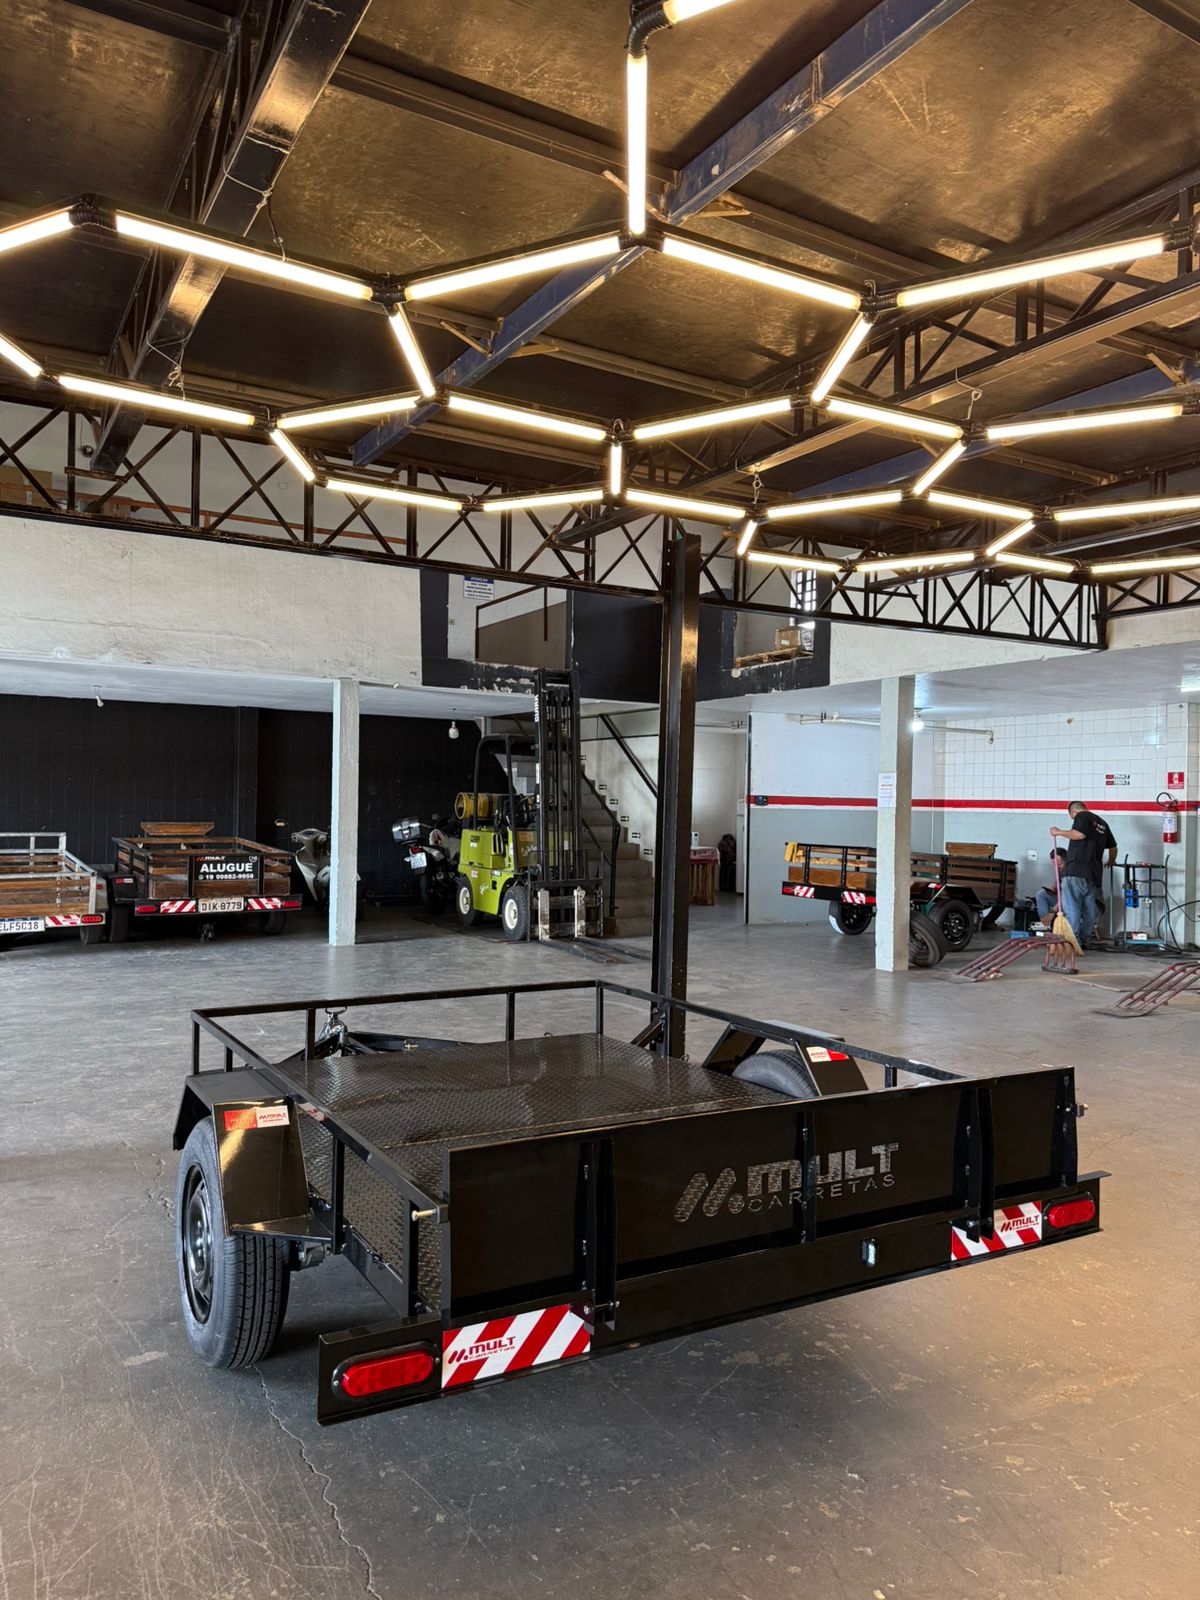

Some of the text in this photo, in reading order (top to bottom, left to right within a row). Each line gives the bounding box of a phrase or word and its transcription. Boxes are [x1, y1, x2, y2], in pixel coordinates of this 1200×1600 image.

[200, 862, 254, 873] ALUGUE
[1012, 1214, 1040, 1227] MULT
[468, 1336, 516, 1355] MULT
